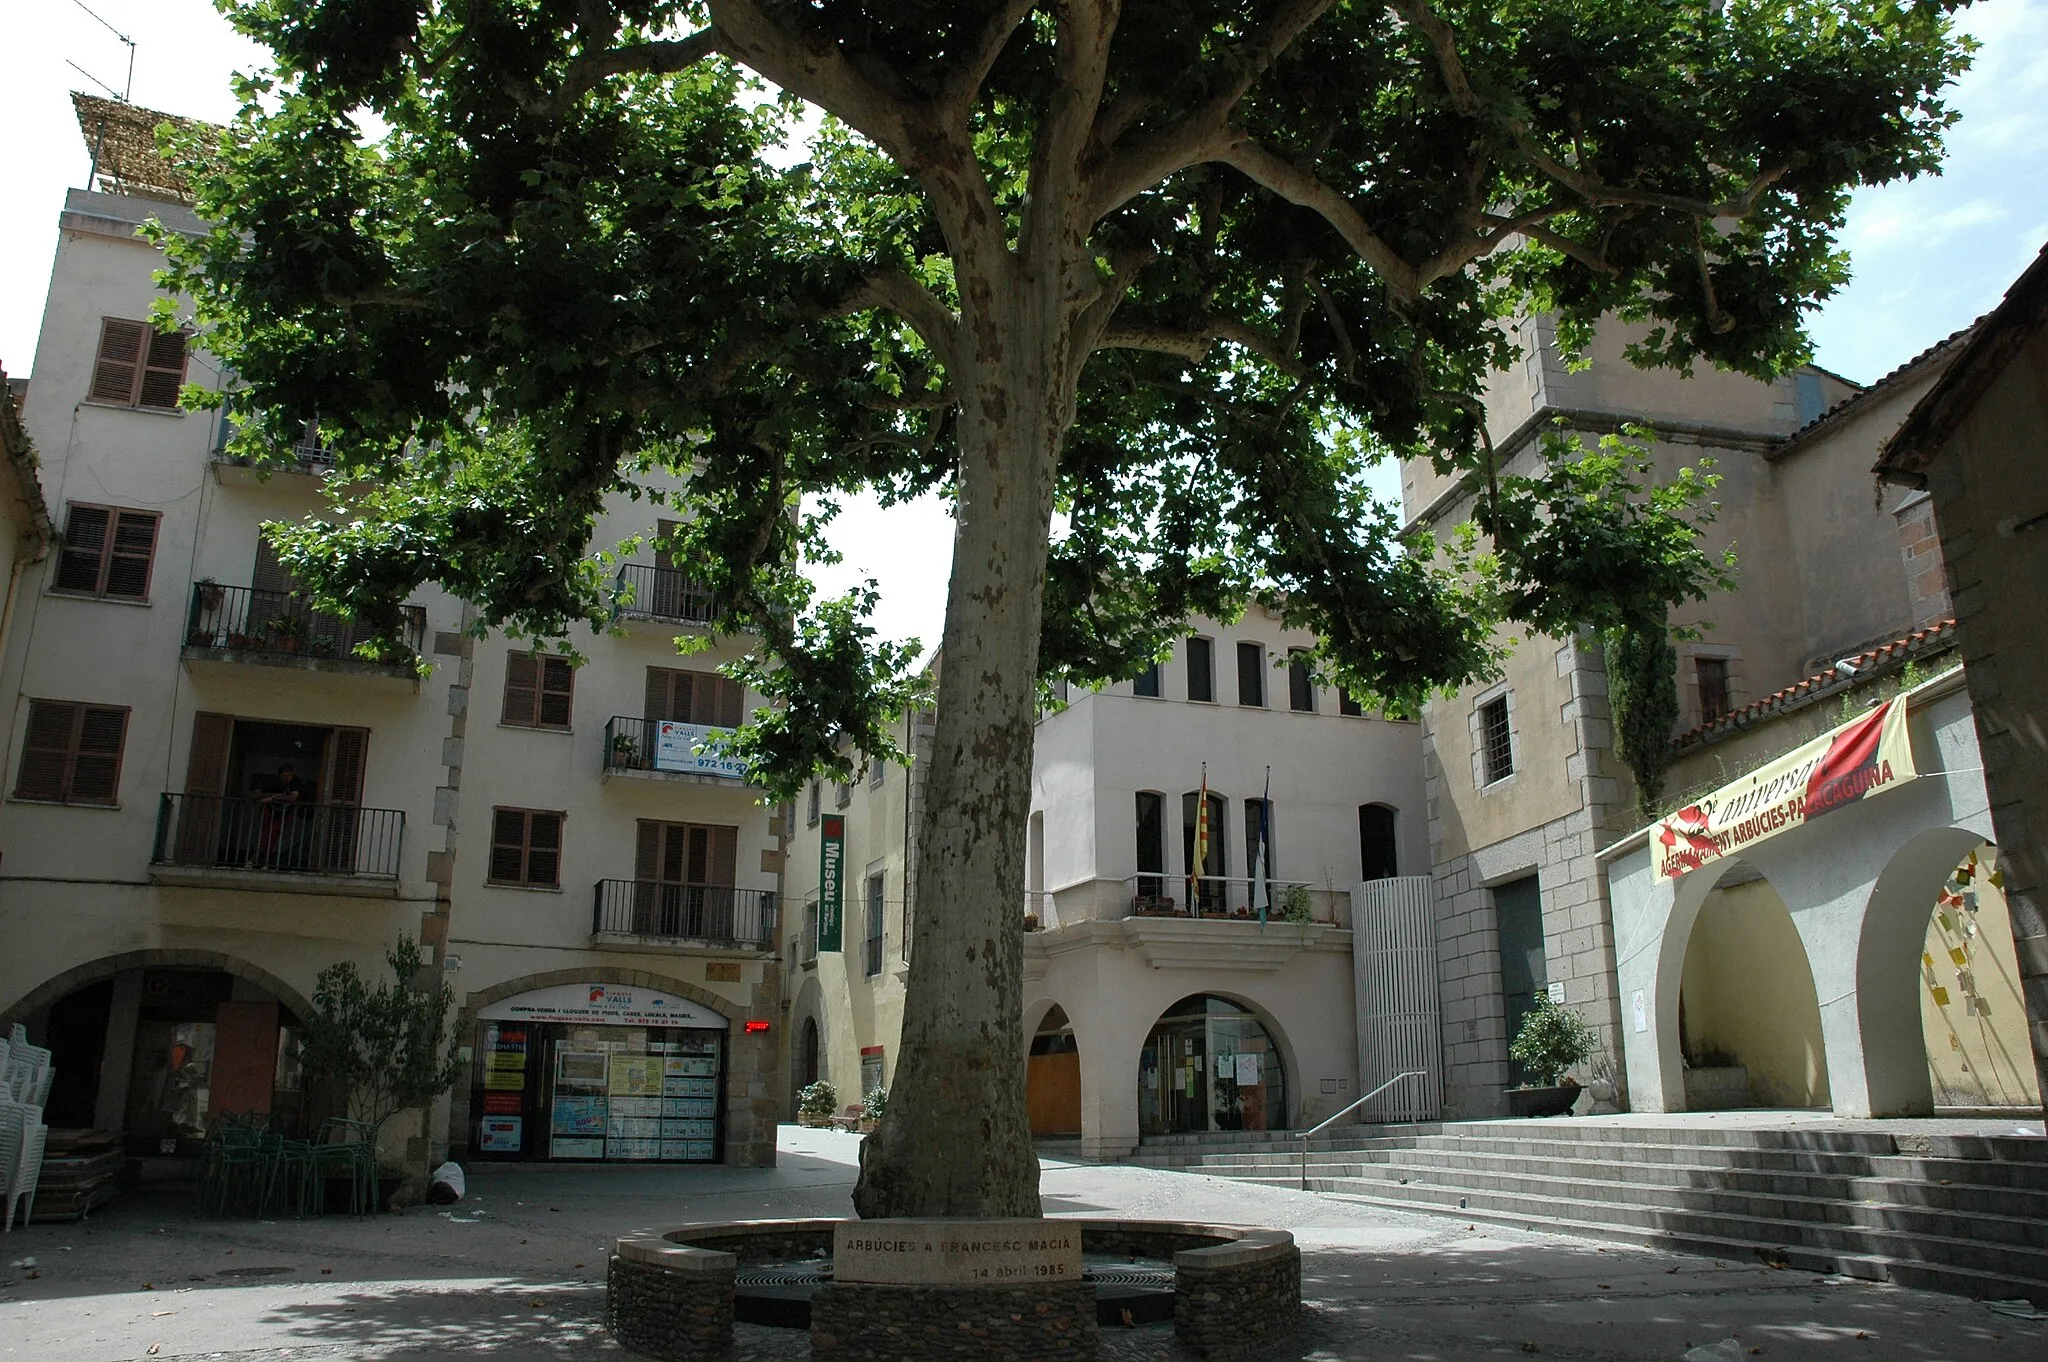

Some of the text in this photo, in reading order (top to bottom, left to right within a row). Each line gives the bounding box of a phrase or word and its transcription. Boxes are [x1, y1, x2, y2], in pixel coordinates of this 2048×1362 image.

[697, 758, 748, 771] 972 16 27
[824, 842, 840, 901] Museu
[606, 996, 632, 1004] VALLS
[846, 1237, 917, 1252] ARBÚCIES
[925, 1241, 933, 1252] A
[940, 1241, 1020, 1252] FRANCESC
[973, 1263, 1064, 1279] 14 abril 1985
